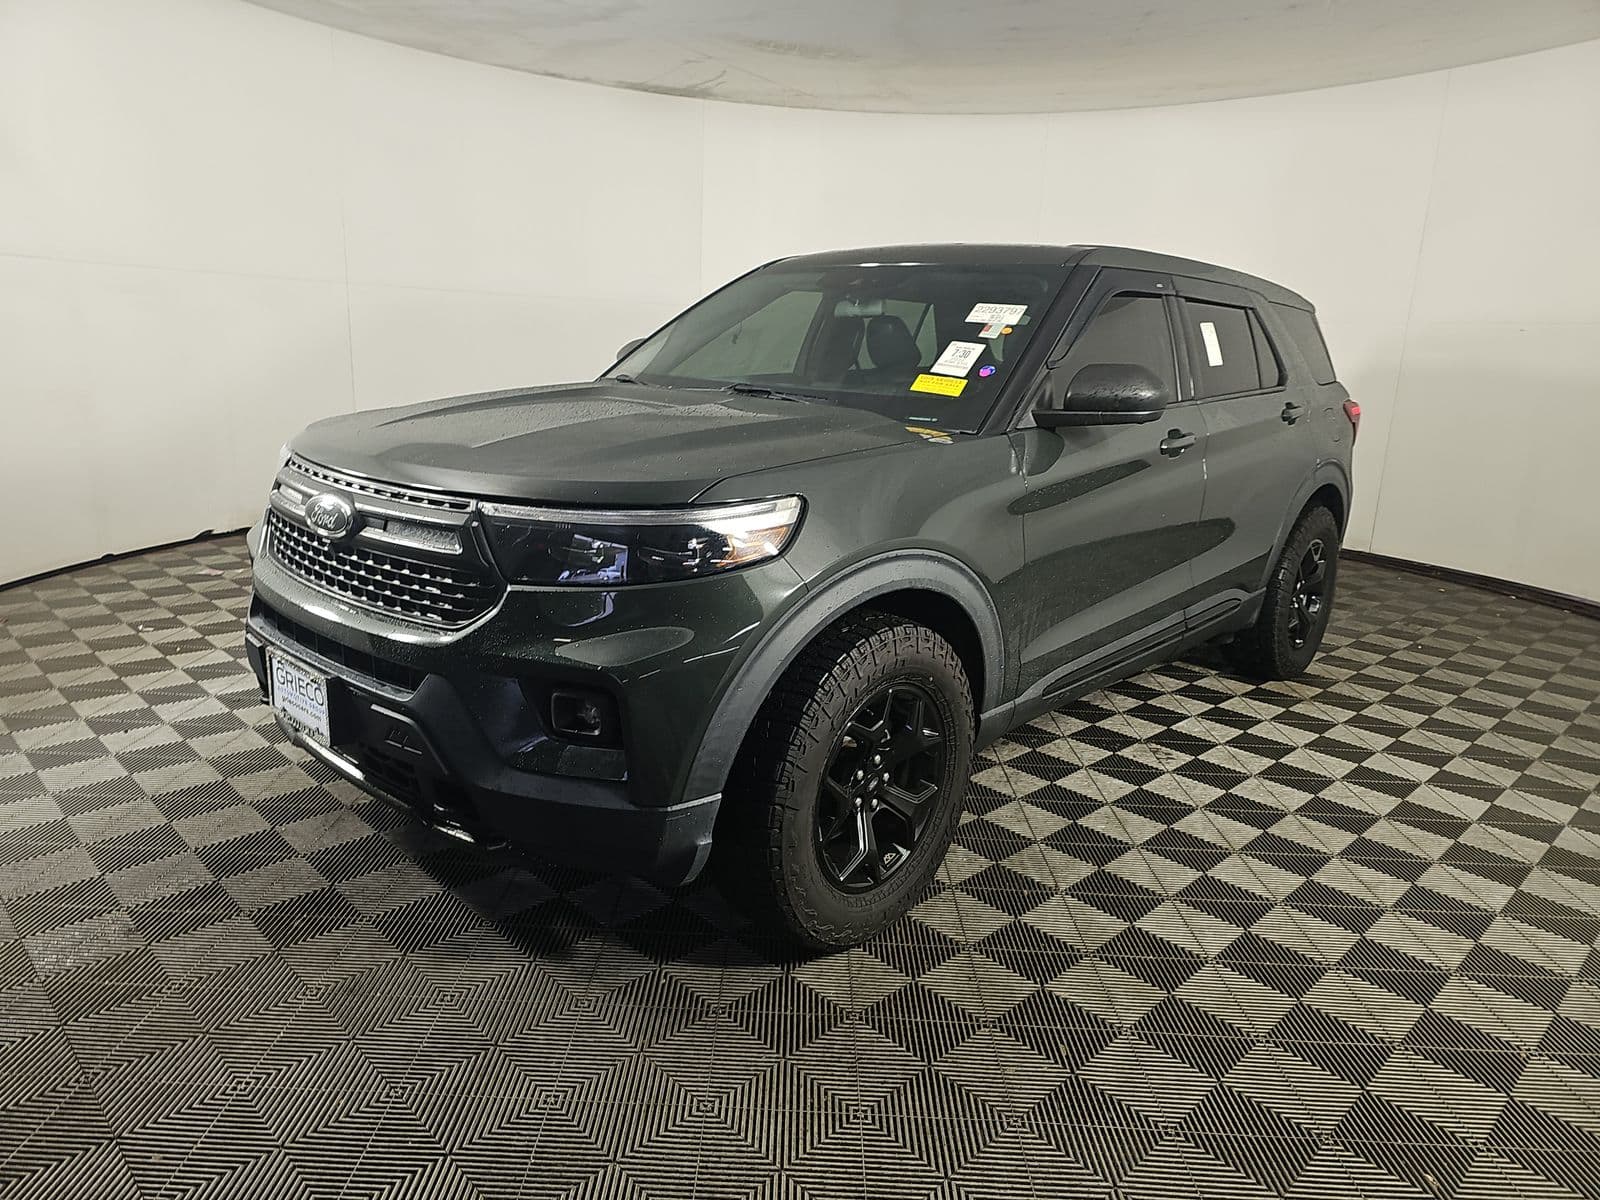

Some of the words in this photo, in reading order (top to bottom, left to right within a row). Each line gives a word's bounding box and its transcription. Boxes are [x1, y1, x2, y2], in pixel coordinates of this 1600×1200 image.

[974, 305, 1025, 315] 2293797
[952, 348, 972, 359] 7:30
[311, 503, 339, 529] Ford
[276, 667, 324, 706] GRIECO
